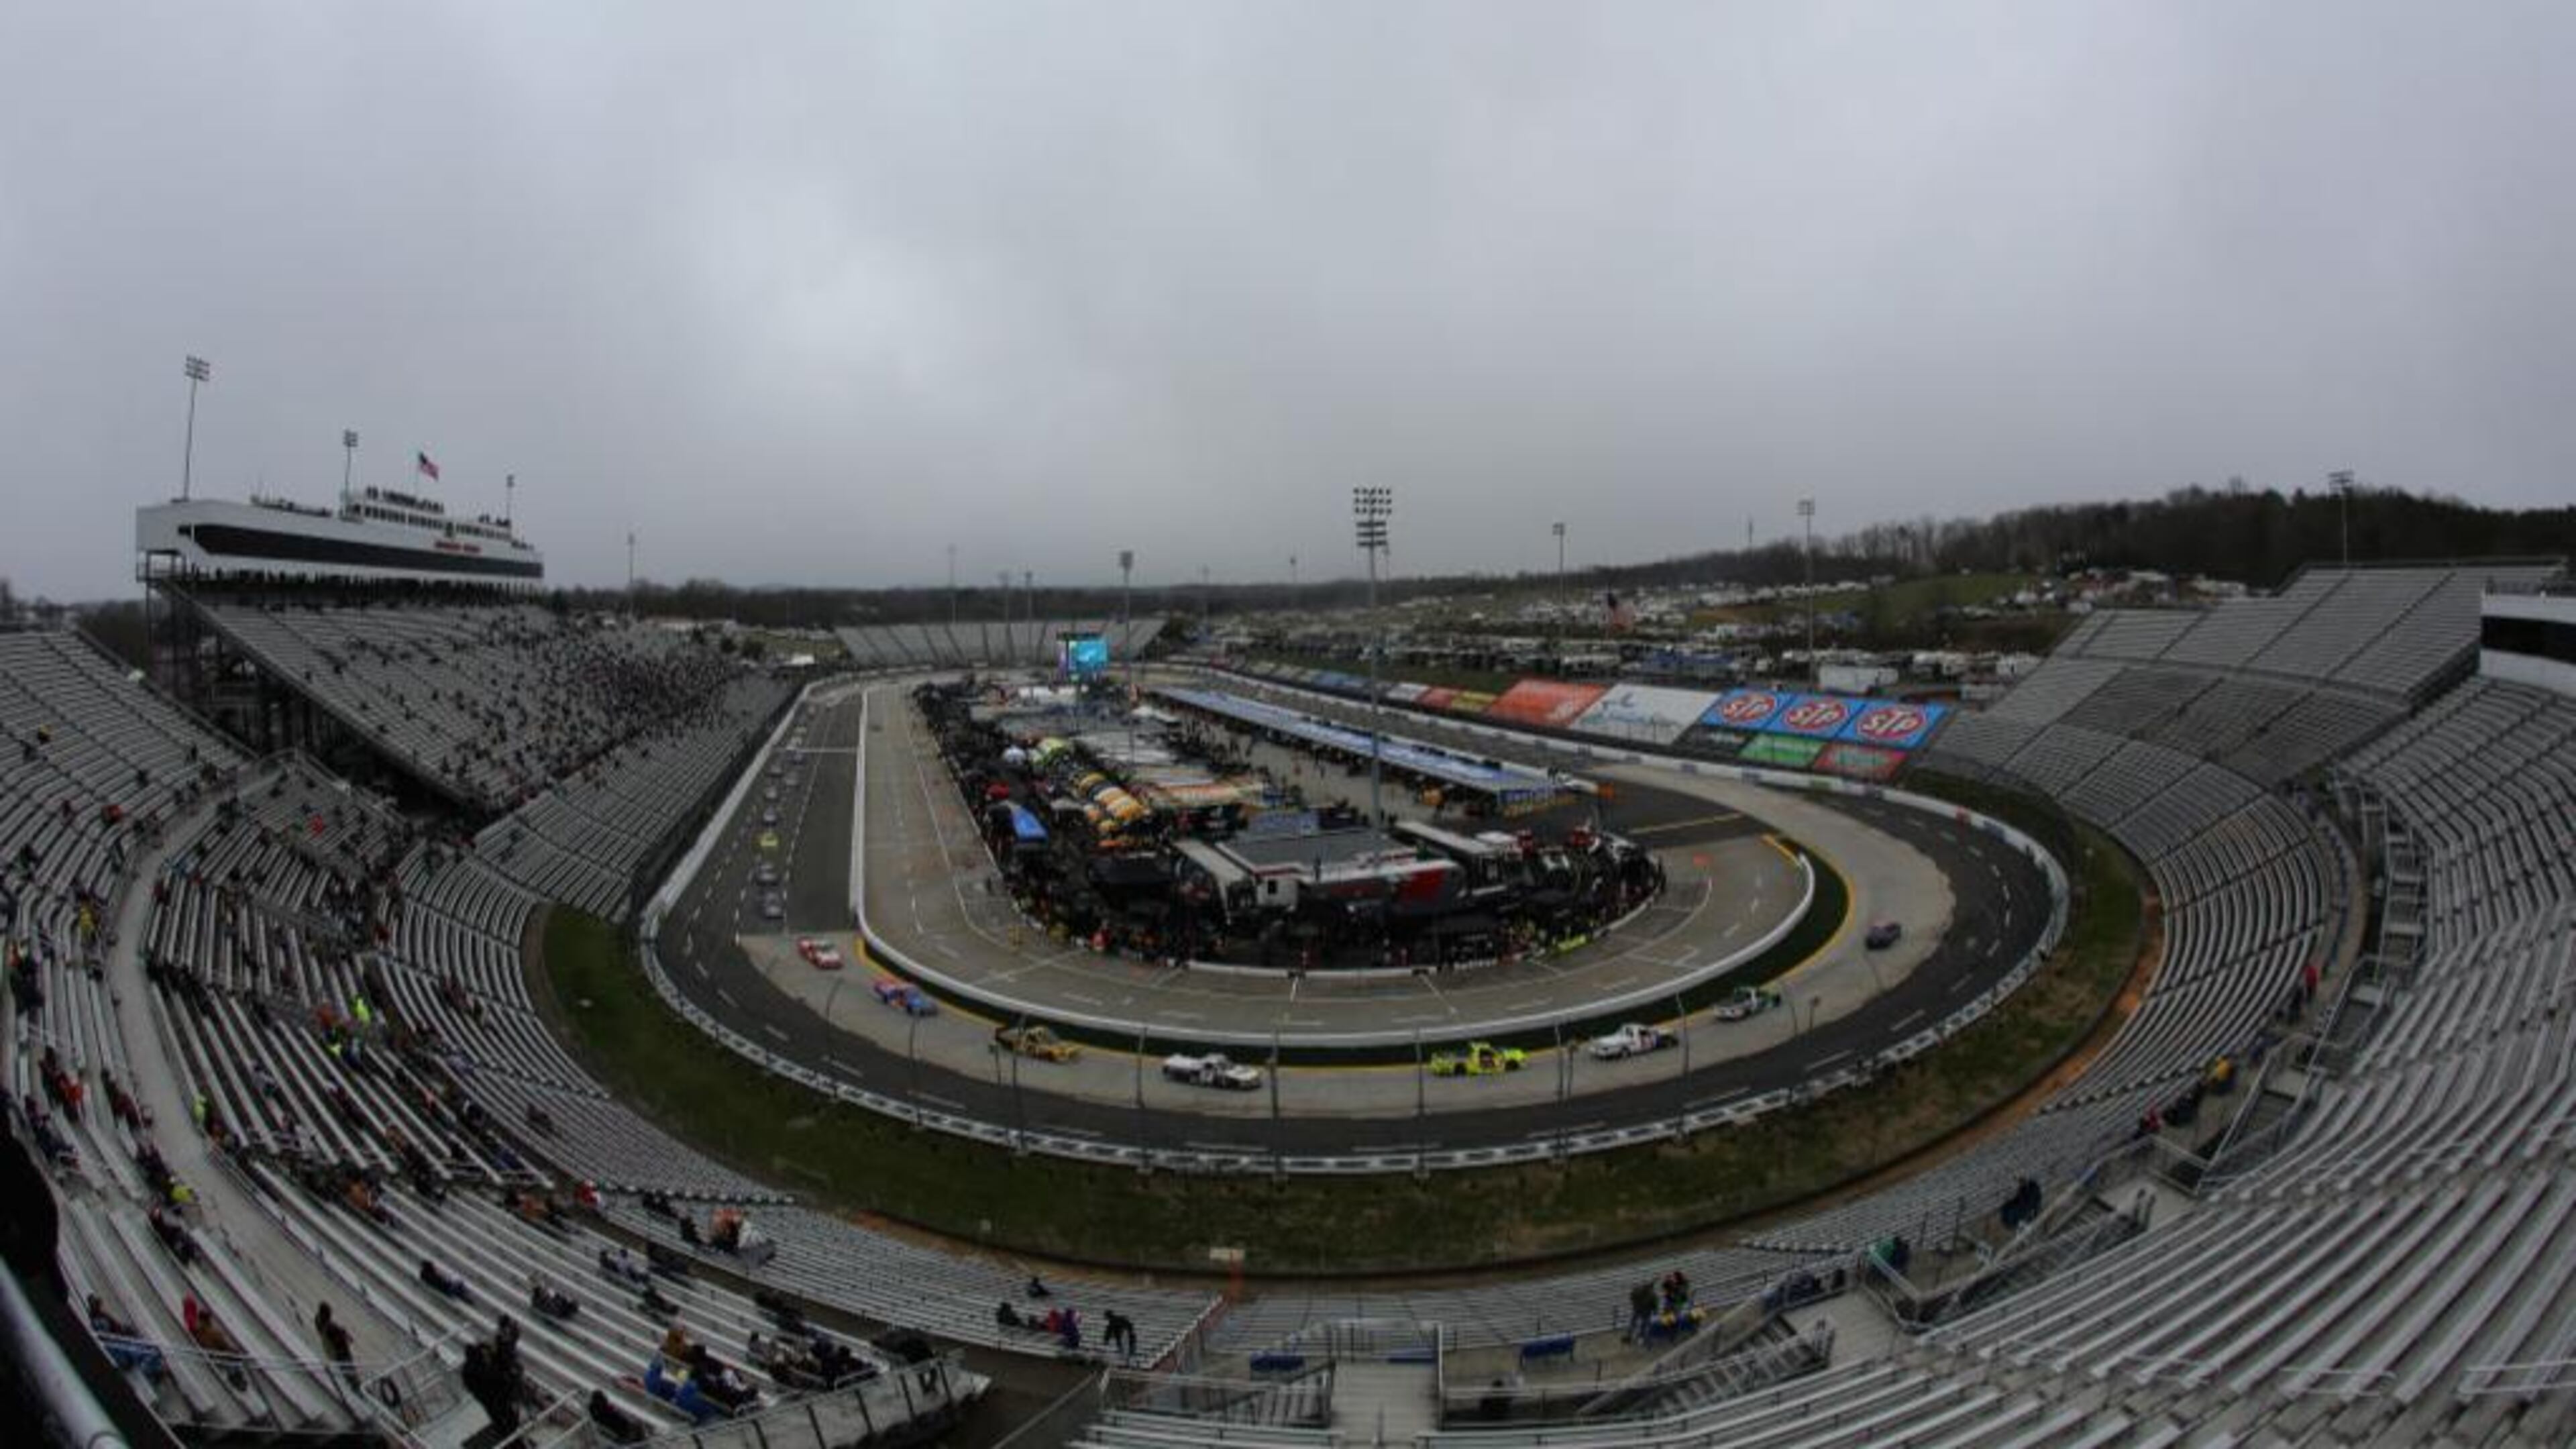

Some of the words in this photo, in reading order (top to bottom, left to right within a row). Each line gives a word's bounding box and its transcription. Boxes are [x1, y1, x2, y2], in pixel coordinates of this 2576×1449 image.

[1723, 695, 1771, 718] STP
[1788, 702, 1841, 725] STP
[1861, 710, 1919, 735] STP
